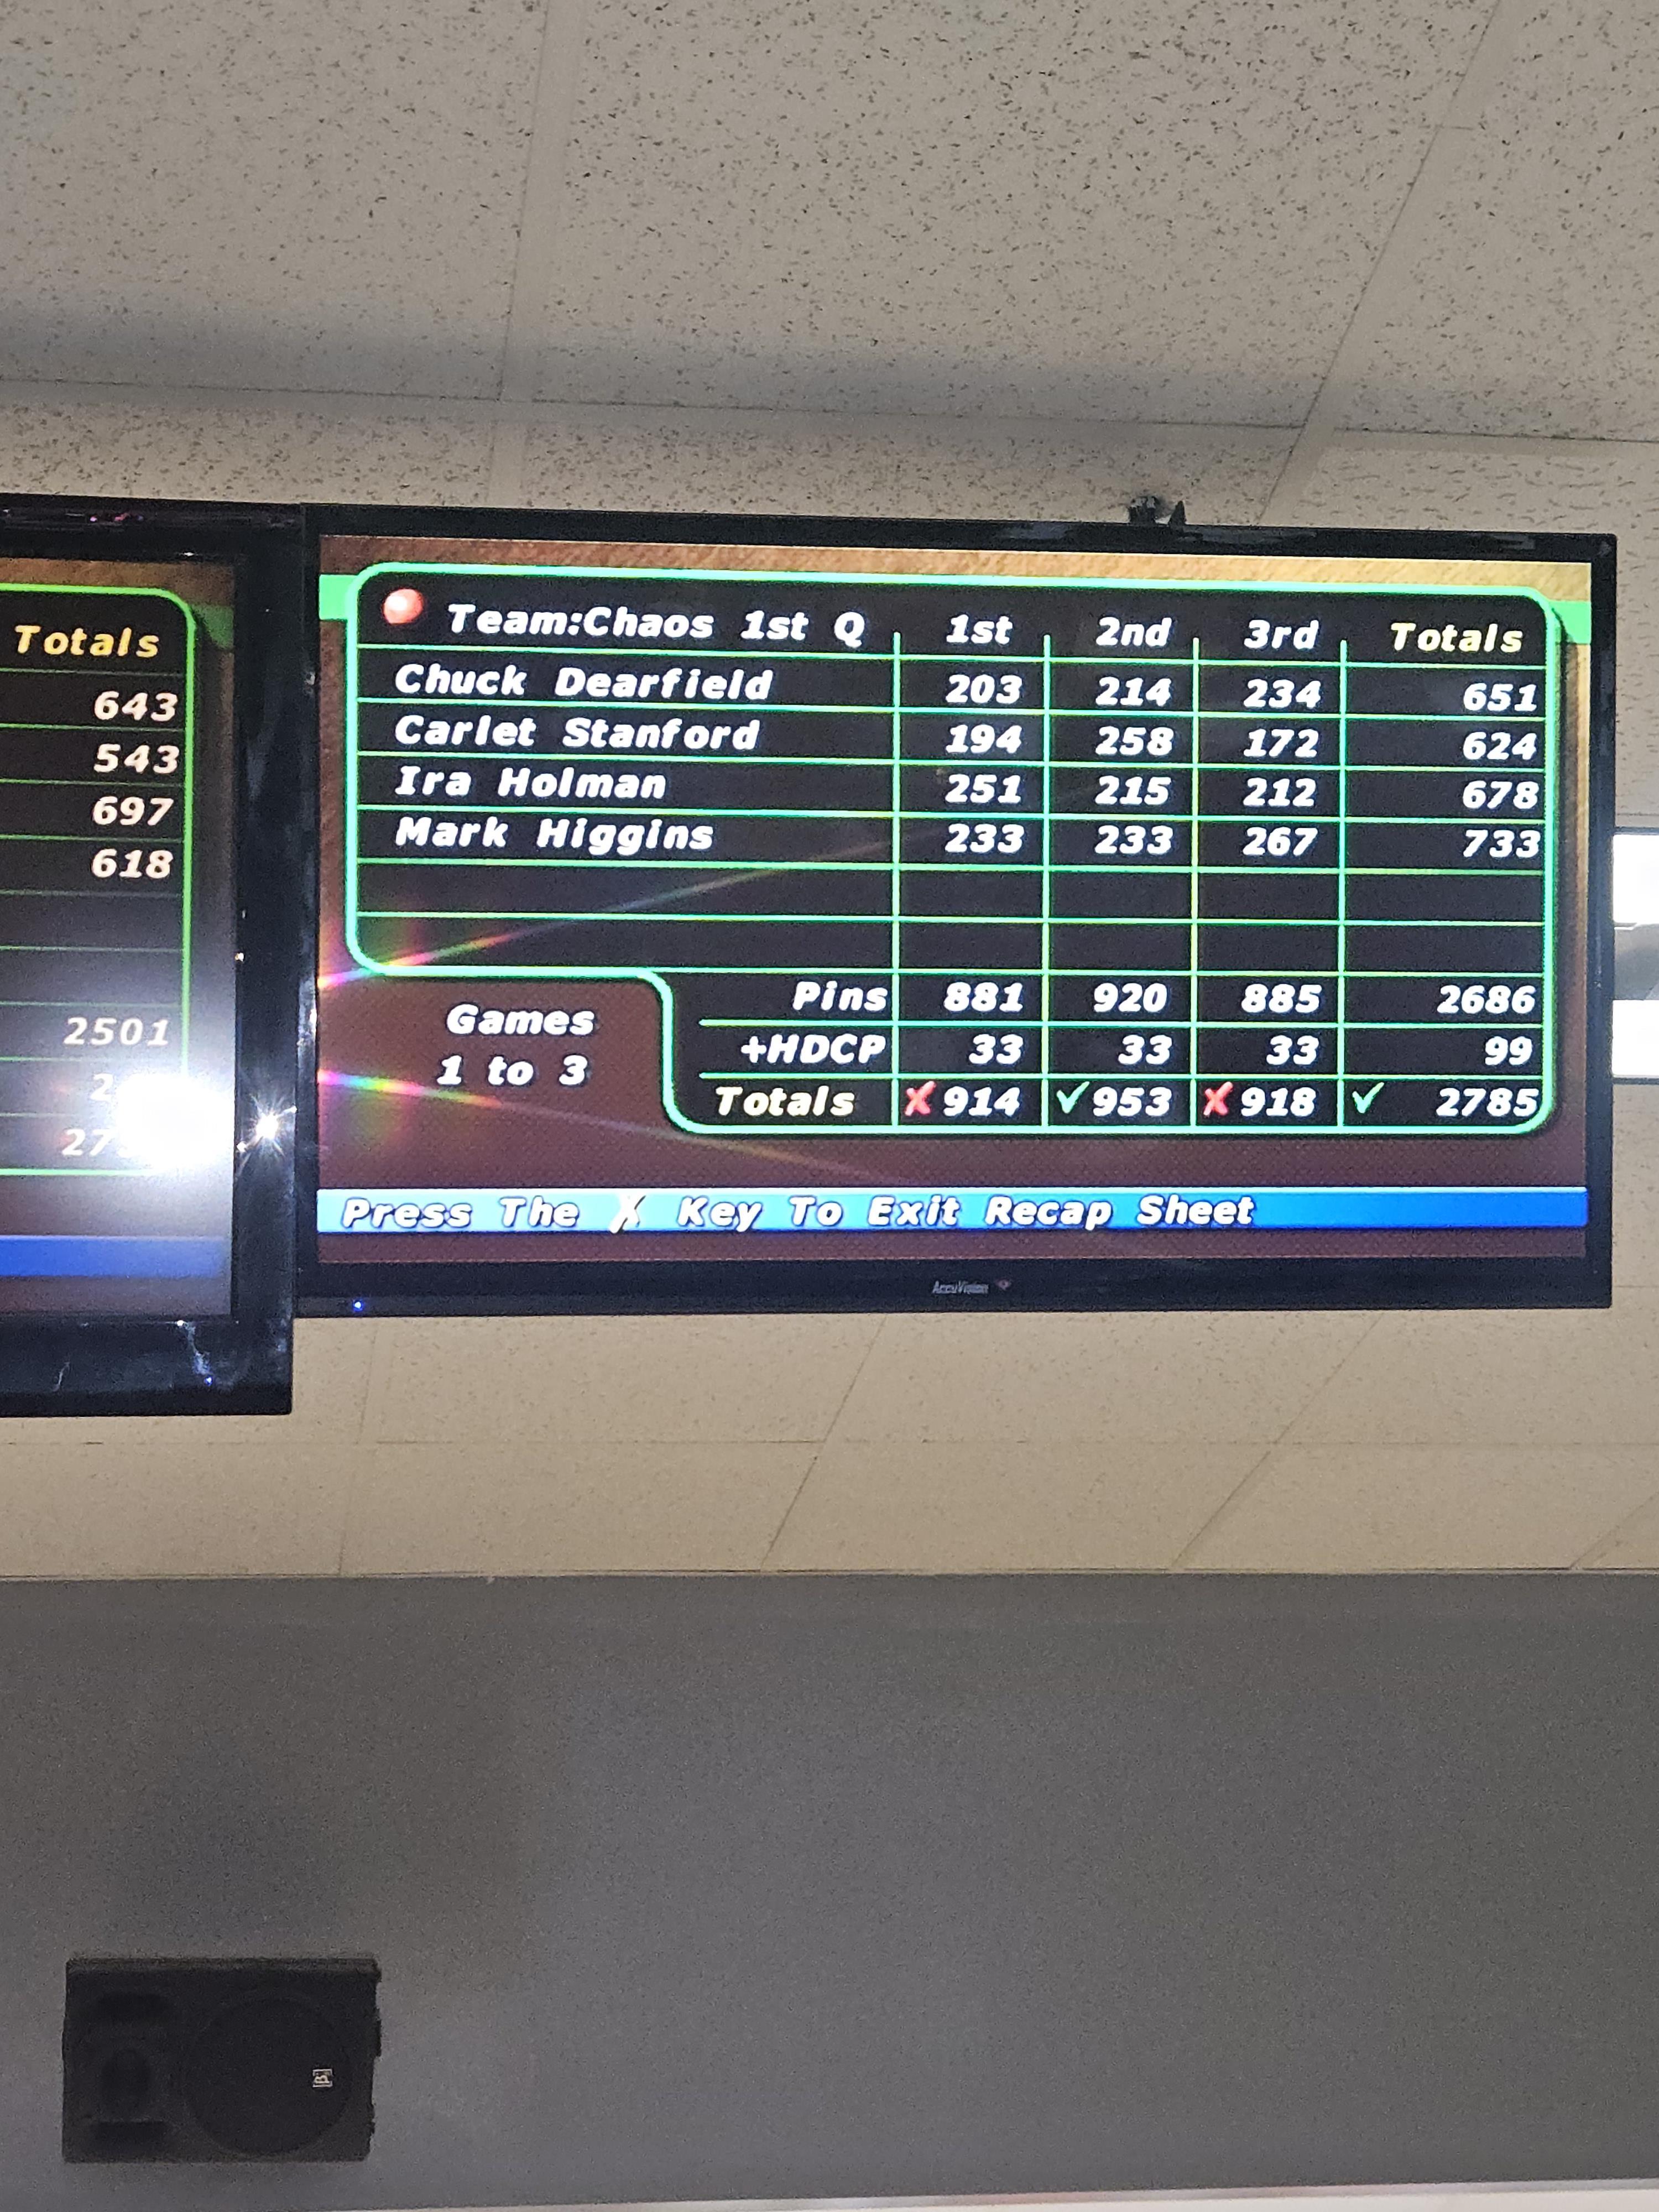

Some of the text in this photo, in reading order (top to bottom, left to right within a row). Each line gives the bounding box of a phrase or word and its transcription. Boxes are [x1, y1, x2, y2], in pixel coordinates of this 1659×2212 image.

[448, 603, 865, 647] Team:Chaos 1st Q
[946, 615, 1013, 644] 1st
[1095, 617, 1172, 647] 2nd
[1244, 619, 1320, 650] 3rd
[1391, 622, 1524, 653] Totals
[14, 625, 160, 658] Totals
[395, 664, 774, 700] Chuck Dearfield
[946, 675, 1022, 705] 203
[1095, 677, 1172, 707] 214
[1244, 680, 1321, 709] 234
[1463, 682, 1538, 712] 651
[94, 691, 178, 721] 643
[395, 716, 760, 750] Carlet Stanford
[946, 725, 1022, 754] 194
[1095, 727, 1173, 756] 258
[1243, 729, 1319, 758] 172
[1463, 732, 1538, 761] 624
[94, 744, 180, 774] 543
[395, 766, 665, 800] Ira Holman
[945, 775, 1022, 805] 251
[1095, 777, 1170, 806] 215
[1243, 779, 1316, 807] 212
[1462, 780, 1539, 810] 678
[92, 796, 174, 826] 697
[395, 816, 713, 855] Mark Higgins
[945, 825, 1023, 854] 233
[1095, 826, 1173, 855] 233
[1243, 827, 1318, 857] 267
[1463, 829, 1540, 858] 733
[91, 849, 173, 879] 618
[793, 981, 886, 1012] Pins
[944, 983, 1023, 1013] 881
[1093, 984, 1167, 1013] 920
[1242, 985, 1322, 1014] 885
[1437, 985, 1535, 1015] 2686
[64, 1017, 169, 1047] 2501
[446, 1004, 596, 1036] Games
[742, 1035, 886, 1066] +HDCP
[968, 1034, 1023, 1066] 33
[1118, 1035, 1172, 1066] 33
[1266, 1035, 1320, 1066] 33
[1484, 1036, 1532, 1067] 99
[437, 1056, 588, 1086] 1 to 3
[716, 1087, 855, 1117] Totals
[943, 1086, 1021, 1118] 914
[1093, 1086, 1171, 1117] 953
[1240, 1086, 1316, 1118] 918
[1437, 1087, 1537, 1118] 2785
[342, 1198, 472, 1228] Press
[500, 1197, 578, 1227] The
[677, 1198, 761, 1233] Key
[790, 1197, 842, 1227] To
[868, 1196, 959, 1227] Exit
[986, 1196, 1112, 1230] Recap
[1137, 1194, 1254, 1228] Sheet
